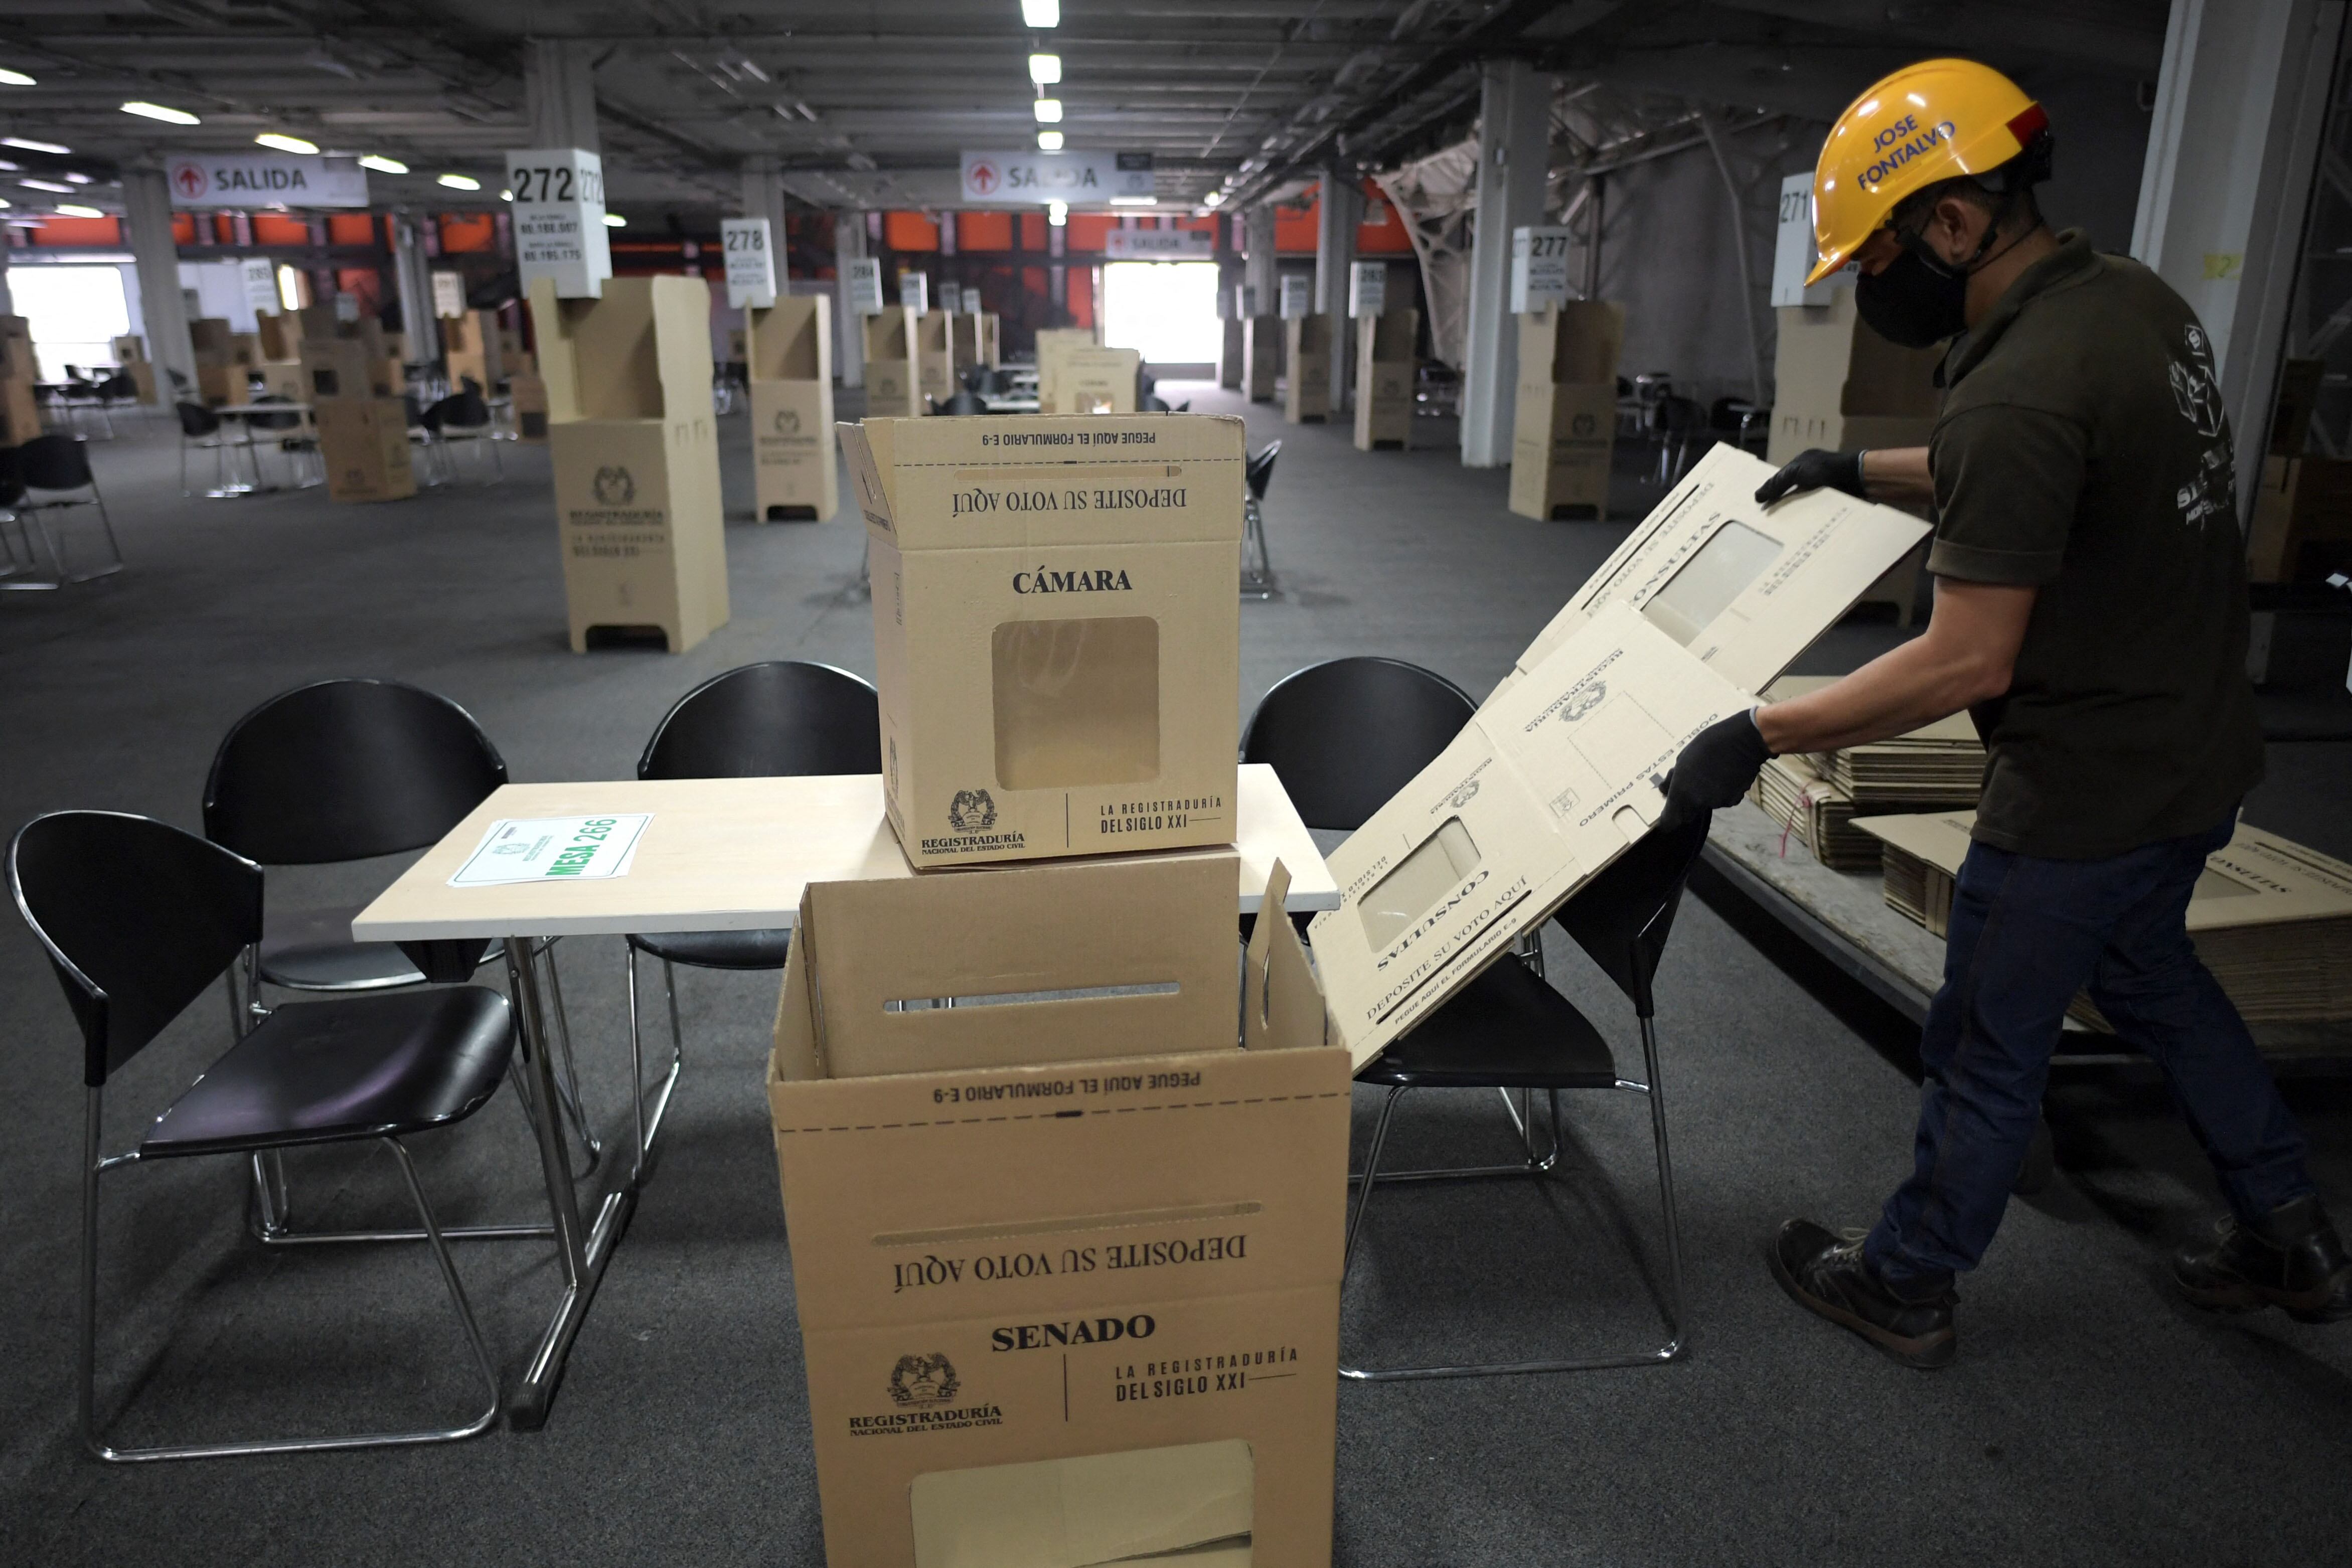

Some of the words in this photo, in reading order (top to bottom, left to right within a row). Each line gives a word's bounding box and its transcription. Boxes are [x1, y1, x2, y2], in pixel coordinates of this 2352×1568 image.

[1873, 114, 1918, 153] JOSE
[1857, 121, 1955, 190] FONTALVO
[215, 168, 308, 191] SALIDA
[514, 168, 574, 203] 272
[1780, 190, 1808, 223] 271
[727, 230, 764, 251] 278
[1532, 236, 1567, 257] 277
[982, 434, 999, 445] E-9
[1003, 433, 1073, 445] FORMULARIO
[1077, 433, 1089, 444] EL
[1093, 432, 1119, 447] AQUÍ
[1122, 432, 1156, 444] PEGUE
[953, 489, 1000, 518] AQUÍ
[1006, 491, 1058, 512] VOTO
[1063, 491, 1087, 510] SU
[1094, 489, 1187, 509] DEPOSITE
[1013, 565, 1133, 594] CÁMARA
[1675, 713, 1718, 747] DOBLE
[1636, 748, 1674, 780] ESTAS
[1101, 805, 1114, 816] LA
[1122, 796, 1221, 814] REGISTRADURÍA
[1580, 781, 1634, 827] PRIMERO
[1167, 814, 1187, 829] XXI
[545, 844, 600, 876] MESA
[573, 819, 617, 842] 266
[921, 831, 1025, 848] REGISTRADURÍA
[922, 847, 958, 855] NACIONAL
[1377, 870, 1489, 972] CONSULTAS
[1367, 960, 1431, 1020] DEPOSITE
[1434, 942, 1451, 962] SU
[1454, 909, 1489, 942] VOTO
[1494, 875, 1527, 909] AQUÍ
[1394, 1001, 1420, 1025] PEGUE
[1421, 982, 1440, 1002] AQUÍ
[1441, 976, 1451, 985] EL
[1452, 929, 1502, 976] FORMULARIO
[1503, 917, 1517, 930] E-9
[965, 1080, 1074, 1101] FORMULARIO
[1079, 1078, 1098, 1093] EL
[1105, 1074, 1143, 1095] AQUÍ
[1148, 1072, 1201, 1089] PEGUE
[933, 1086, 960, 1103] E-9
[1061, 1247, 1096, 1273] SU
[1107, 1234, 1246, 1269] DEPOSITE
[893, 1255, 967, 1293] AQUÍ
[974, 1252, 1052, 1280] VOTO
[992, 1314, 1155, 1352] SENADO
[1116, 1365, 1135, 1380] LA
[1148, 1346, 1297, 1376] REGISTRADURÍA
[1216, 1371, 1244, 1391] XXI
[849, 1403, 1002, 1428] REGISTRADURÍA
[850, 1426, 903, 1437] NACIONAL
[906, 1424, 928, 1433] DEL
[931, 1420, 972, 1430] ESTADO
[975, 1418, 1003, 1427] CIVIL
